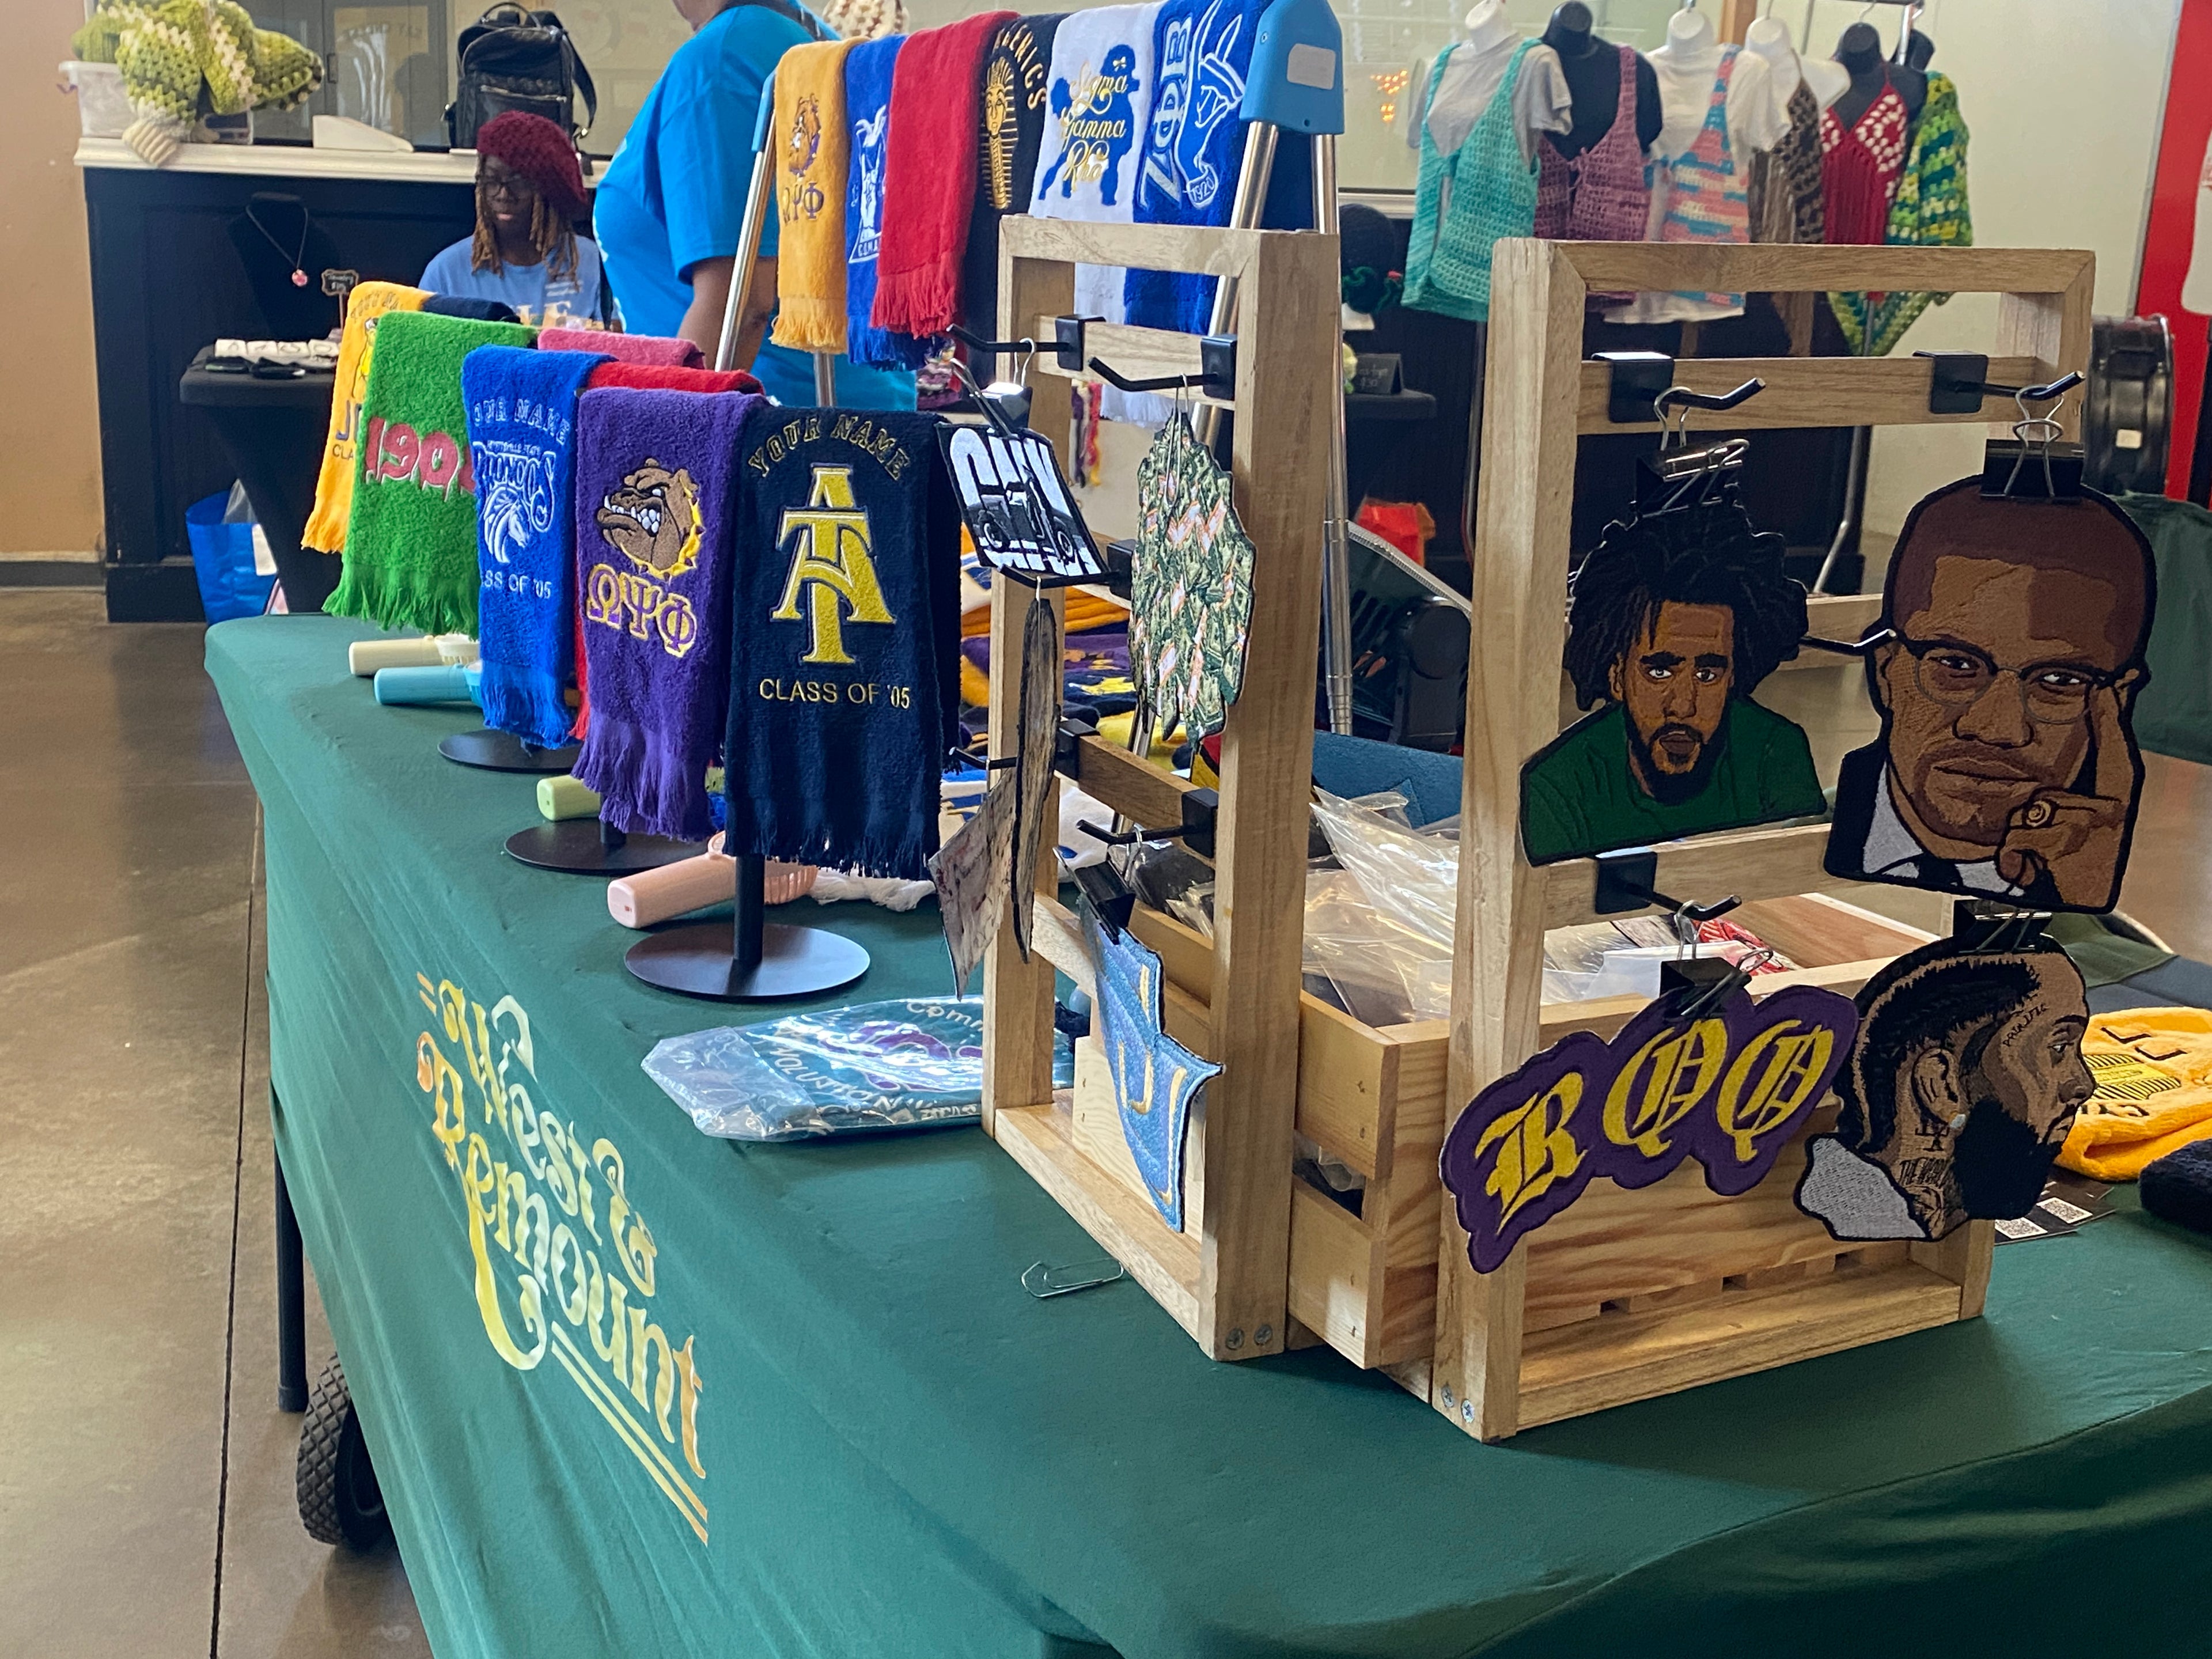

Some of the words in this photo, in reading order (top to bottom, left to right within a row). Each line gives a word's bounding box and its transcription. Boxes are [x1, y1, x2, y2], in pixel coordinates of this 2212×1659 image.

[1069, 60, 1128, 115] Sigma
[1060, 107, 1127, 152] Gamma
[1191, 177, 1216, 202] 1920
[514, 397, 570, 446] NAME
[748, 418, 821, 478] YOUR
[830, 414, 911, 481] NAME
[508, 573, 529, 594] OF
[533, 578, 552, 599] '05
[759, 678, 838, 703] CLASS
[847, 683, 881, 704] OF
[887, 684, 910, 709] '05
